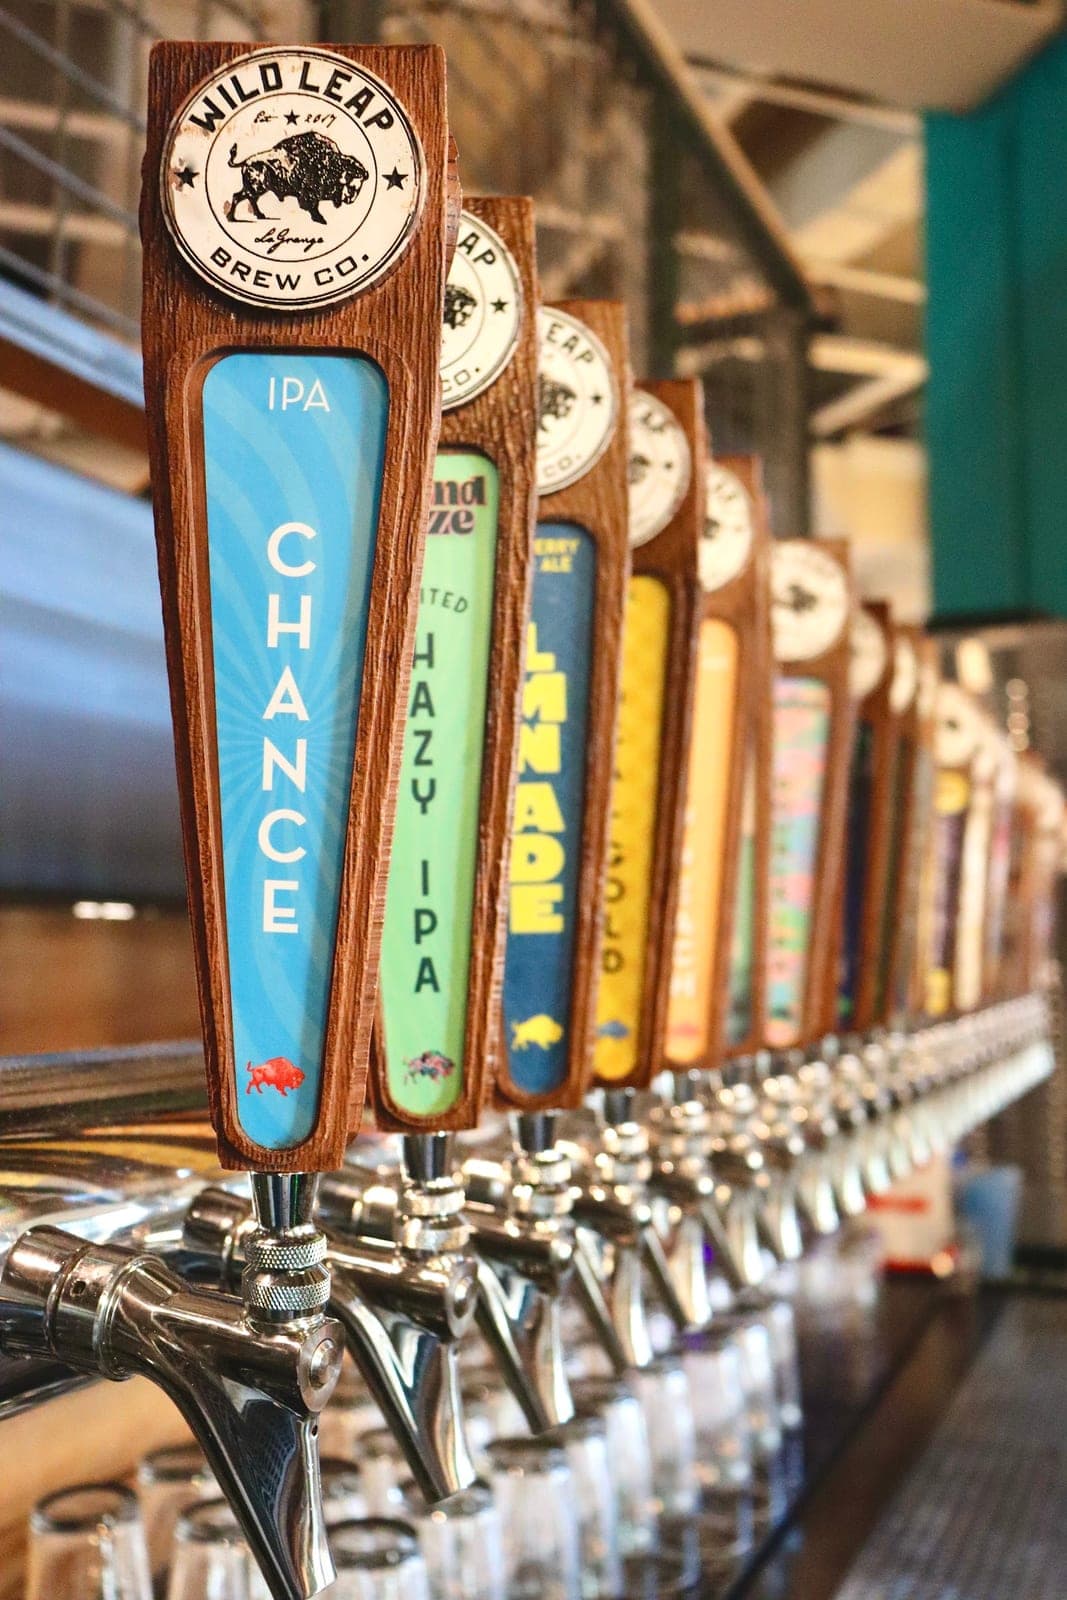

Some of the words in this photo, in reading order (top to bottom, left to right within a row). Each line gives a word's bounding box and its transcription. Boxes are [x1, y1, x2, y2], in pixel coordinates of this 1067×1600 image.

[188, 62, 284, 134] WILD
[299, 61, 394, 131] LEAP
[210, 246, 301, 291] BREW
[313, 253, 370, 287] CO.
[546, 321, 594, 364] EAP
[268, 377, 330, 412] IPA
[257, 521, 318, 935] CHANCE
[409, 632, 437, 816] HAZY
[413, 860, 441, 993] IPA
